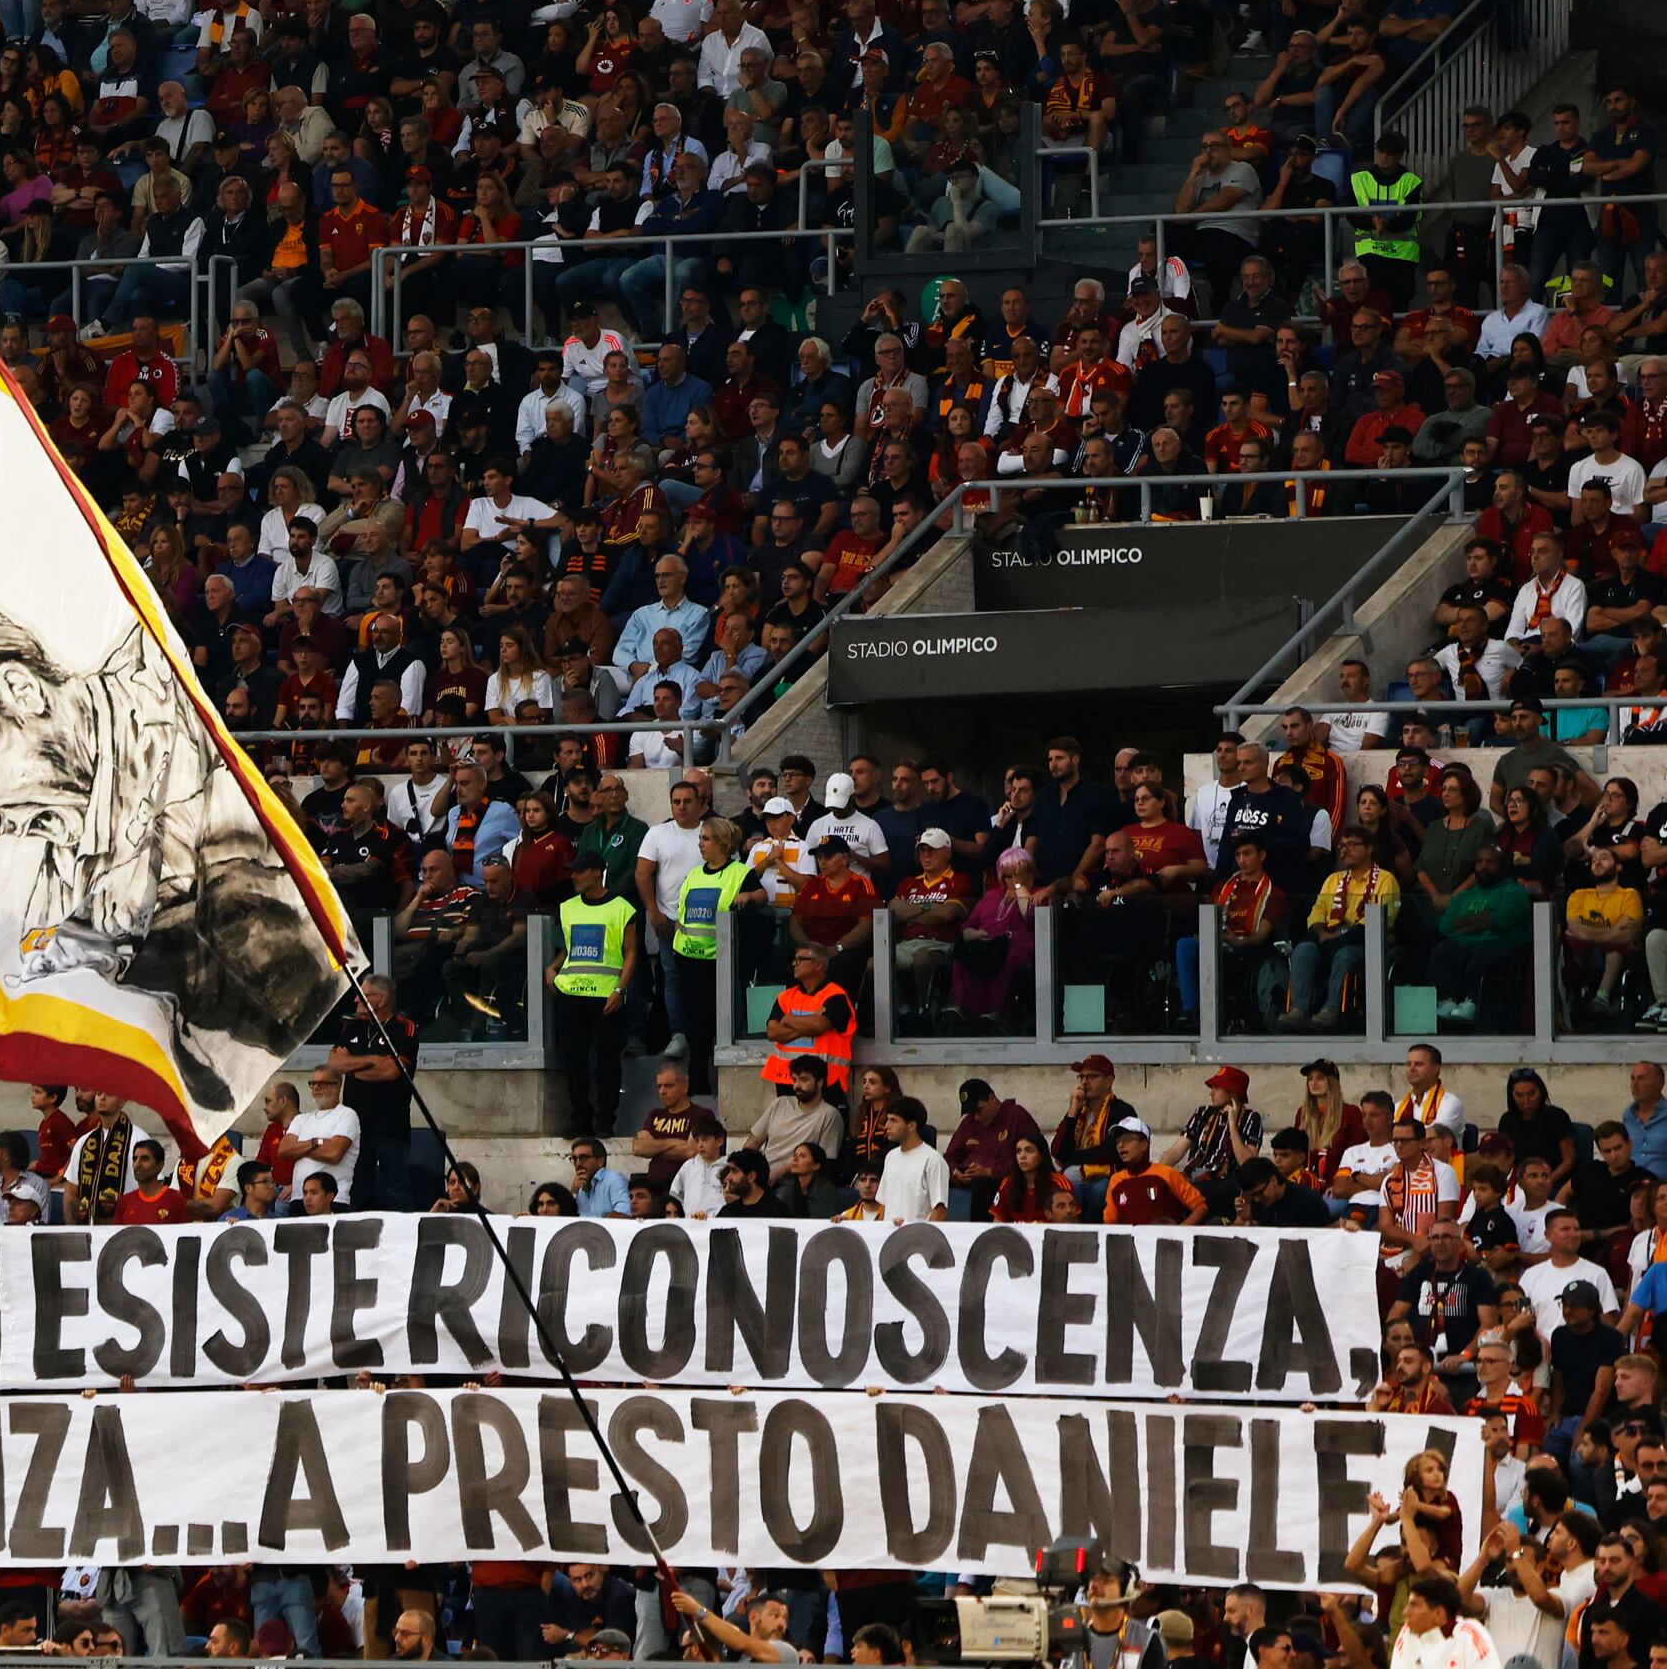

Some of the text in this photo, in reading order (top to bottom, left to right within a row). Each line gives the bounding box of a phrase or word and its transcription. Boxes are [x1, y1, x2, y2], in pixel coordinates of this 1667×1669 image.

[1056, 547, 1143, 566] OLIMPICO
[847, 636, 998, 660] STADIO OLIMPICO
[105, 1132, 129, 1188] DAJE
[31, 1218, 385, 1380] ESISTE
[407, 1216, 1378, 1399] RICONOSCENZA,
[381, 1392, 845, 1565] PRESTO
